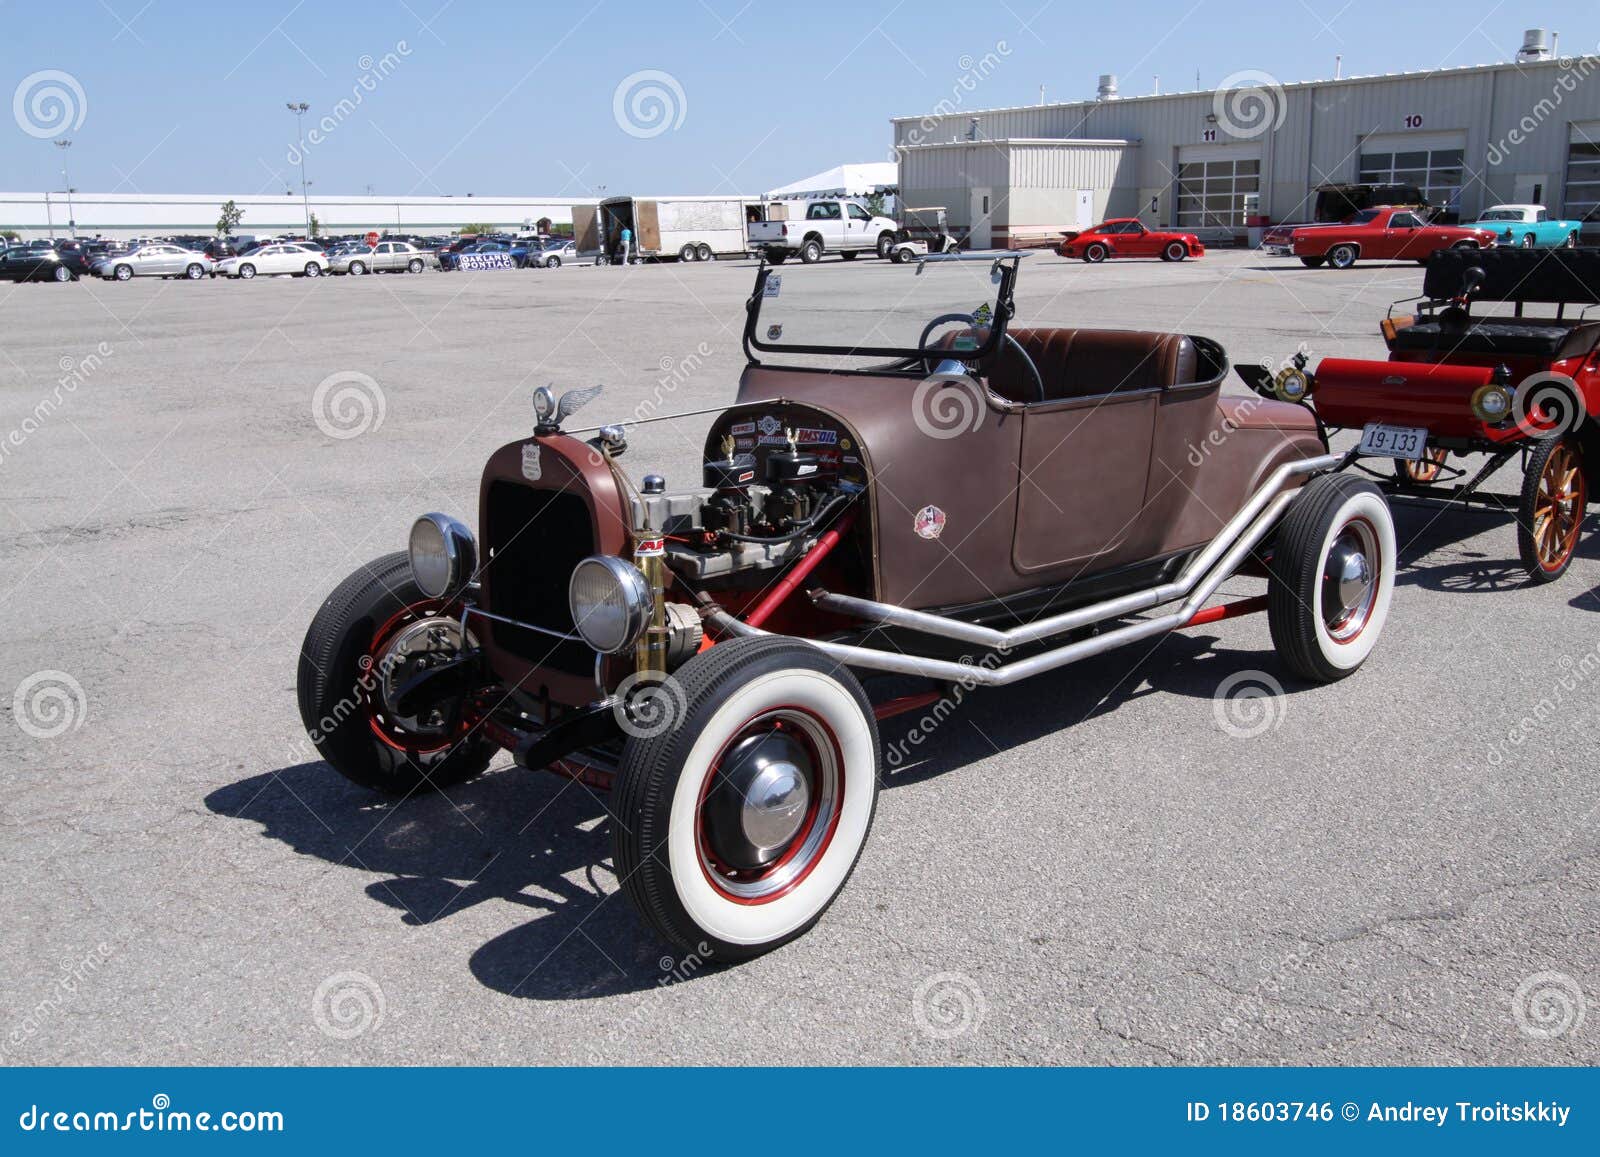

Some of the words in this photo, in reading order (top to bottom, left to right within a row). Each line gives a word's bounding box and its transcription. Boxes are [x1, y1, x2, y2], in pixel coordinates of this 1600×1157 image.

[1405, 115, 1422, 127] 10
[1204, 130, 1216, 141] 11
[462, 254, 509, 262] OAKLAND
[462, 260, 510, 269] PONTIAC
[1367, 431, 1418, 452] 19-133
